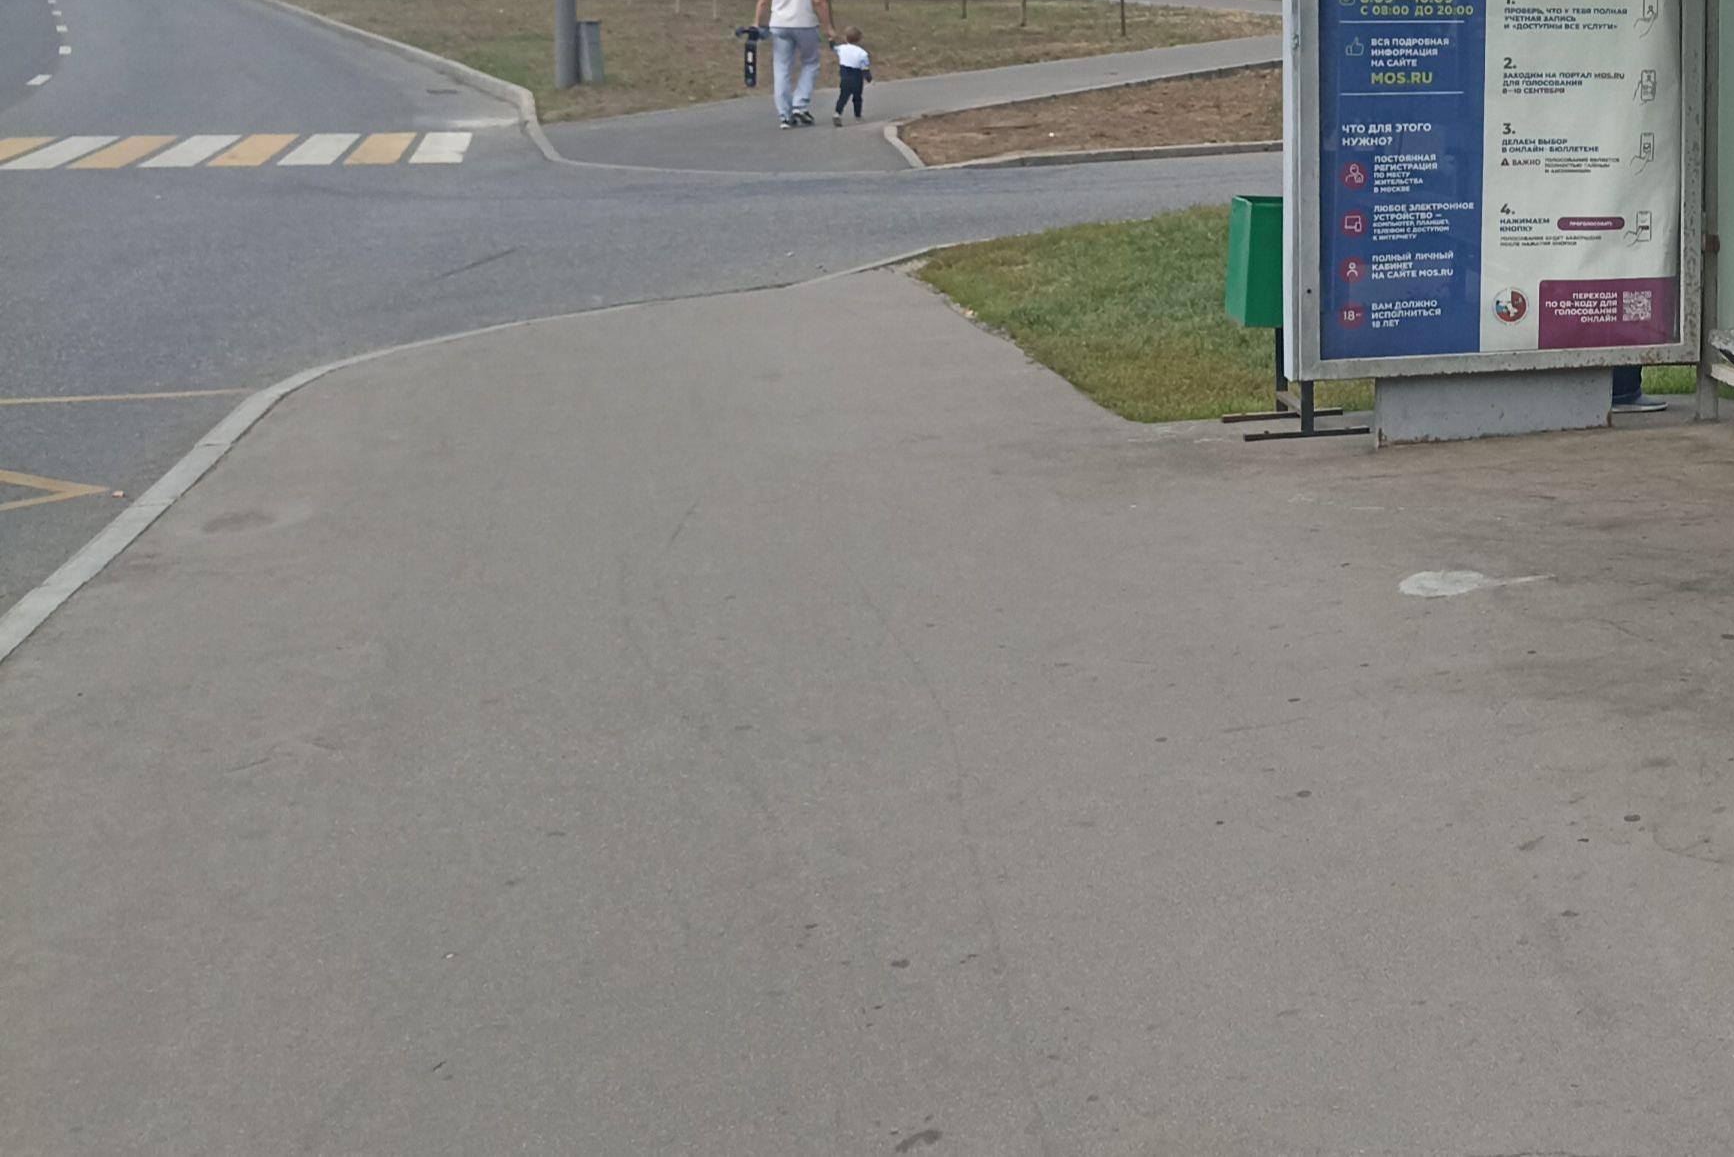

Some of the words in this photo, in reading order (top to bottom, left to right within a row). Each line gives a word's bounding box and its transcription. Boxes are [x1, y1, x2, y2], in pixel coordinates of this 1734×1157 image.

[1372, 5, 1409, 15] 08:00
[1415, 6, 1433, 16] ДО
[1437, 6, 1474, 16] 20:00
[1371, 38, 1390, 46] ВСЯ
[1392, 38, 1449, 46] ПОДРОБНАЯ
[1371, 48, 1438, 56] ИНФОРМАЦИЯ
[1387, 58, 1417, 67] САЙТЕ
[1503, 57, 1516, 69] 2.
[1371, 72, 1432, 84] MOS.RU
[1342, 124, 1365, 133] ЧТО
[1368, 124, 1392, 133] ДЛЯ
[1396, 123, 1431, 132] ЭТОГО
[1502, 123, 1516, 135] 3.
[1342, 137, 1392, 146] НУЖНО?
[1374, 154, 1436, 163] ПОСТОЯННАЯ
[1374, 162, 1438, 172] РЕГИСТРАЦИЯ
[1409, 202, 1474, 211] ЭЛЕКТРОННОЕ
[1500, 204, 1515, 214] 4.
[1373, 211, 1432, 221] УСТРОЙСТВО
[1372, 252, 1411, 262] ПОЛНЫЙ
[1415, 250, 1454, 260] ЛИЧНЫЙ
[1372, 262, 1413, 271] КАБИНЕТ
[1387, 270, 1417, 278] САЙТЕ
[1372, 302, 1392, 310] ВАМ
[1395, 300, 1437, 310] ДОЛЖНО
[1372, 308, 1441, 319] ИСПОЛНИТЬСЯ
[1382, 319, 1399, 327] ЛЕТ
[1581, 315, 1617, 323] ОНЛАЙН
